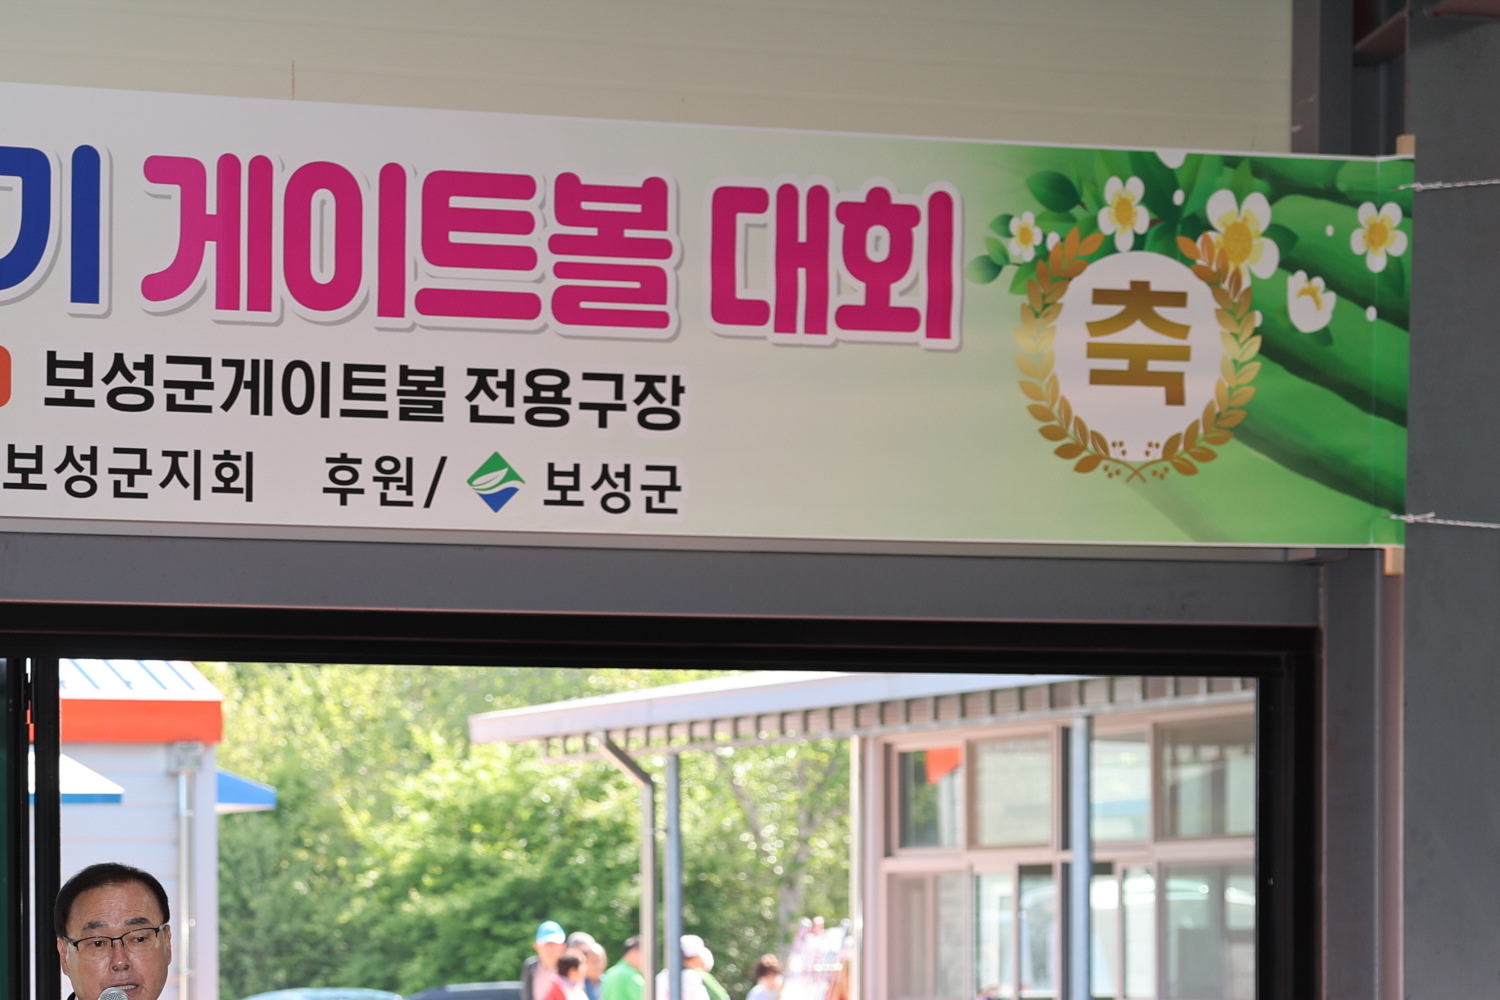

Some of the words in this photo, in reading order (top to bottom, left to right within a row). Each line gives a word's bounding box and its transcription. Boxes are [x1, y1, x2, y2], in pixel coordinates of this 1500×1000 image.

[141, 153, 673, 329] 게이트볼
[710, 183, 954, 340] 대회
[1086, 281, 1192, 407] 축
[44, 350, 446, 423] 보성군게이트볼
[464, 367, 685, 431] 전용구장
[2, 443, 253, 503] 보성군지회
[322, 452, 448, 509] 후원/
[543, 462, 682, 514] 보성군
